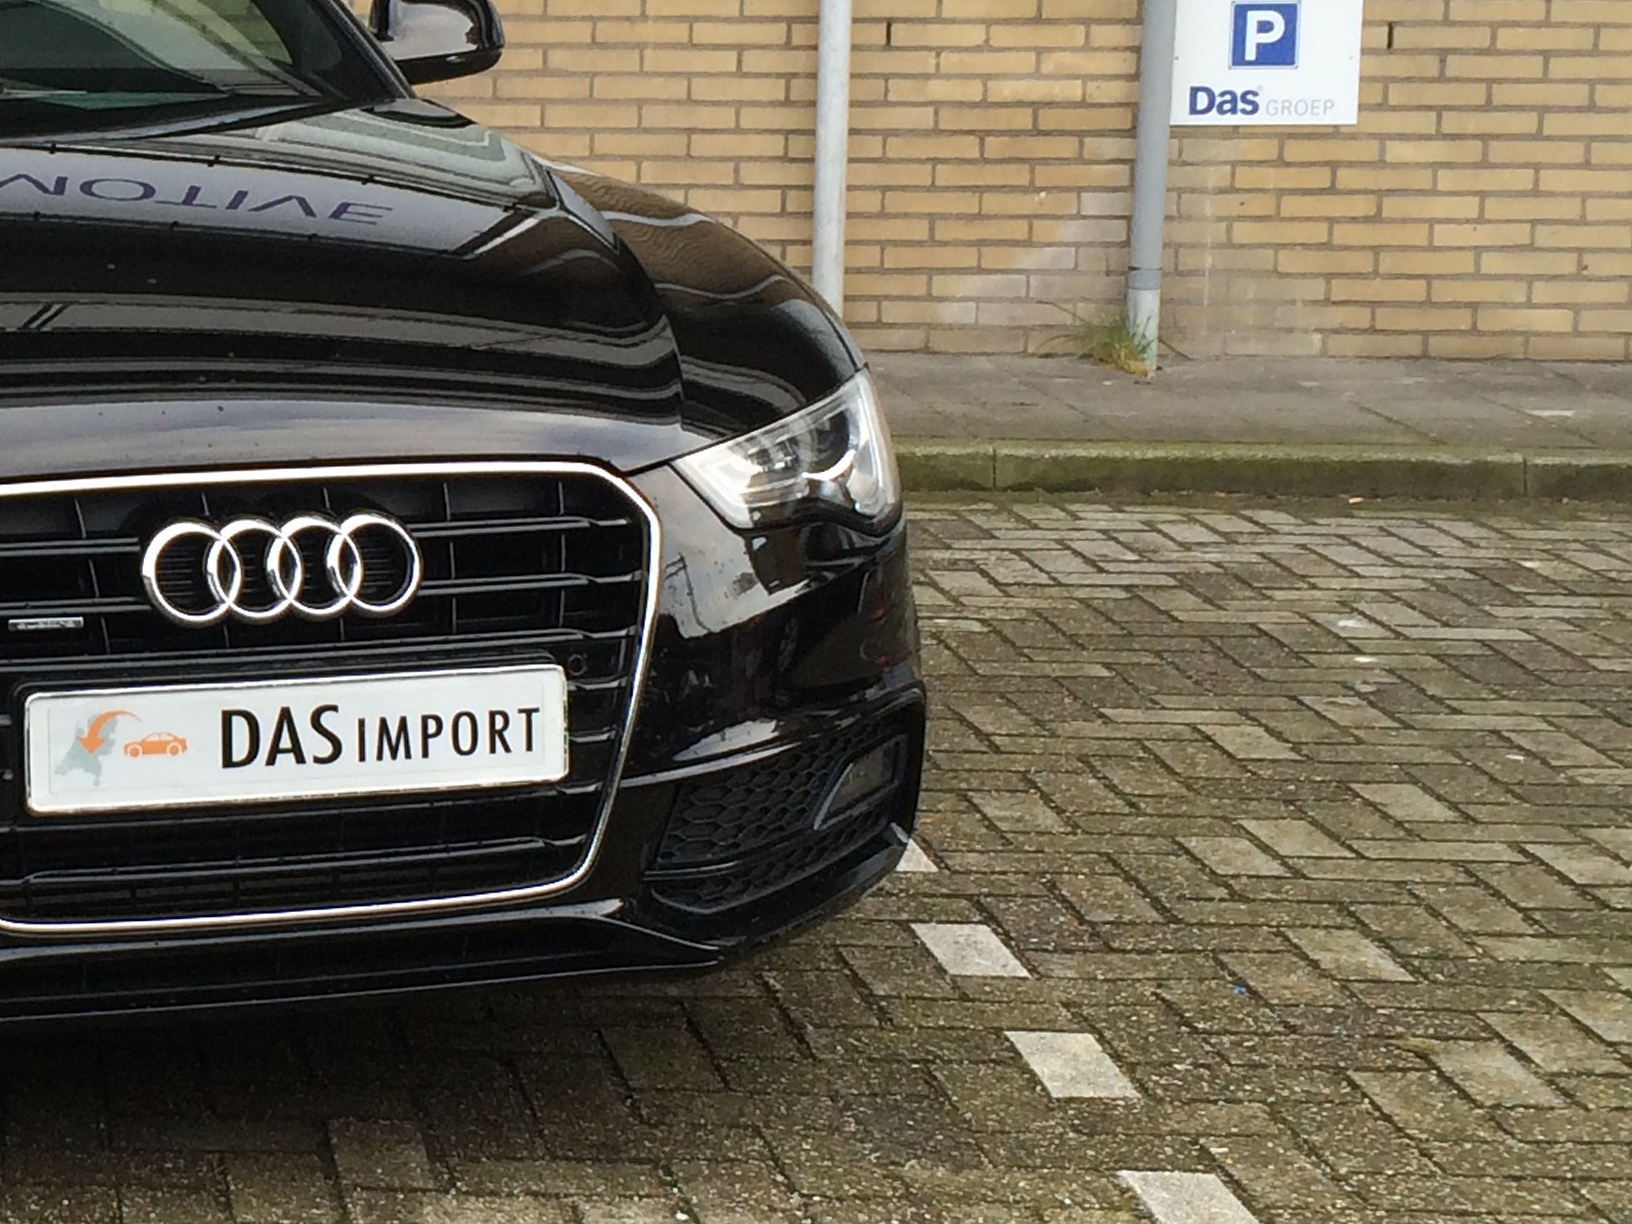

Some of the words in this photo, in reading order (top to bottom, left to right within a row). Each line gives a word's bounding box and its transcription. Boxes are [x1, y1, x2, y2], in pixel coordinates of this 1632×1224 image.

[1244, 10, 1285, 61] P
[1188, 85, 1260, 116] Das
[1265, 99, 1335, 117] GROEP
